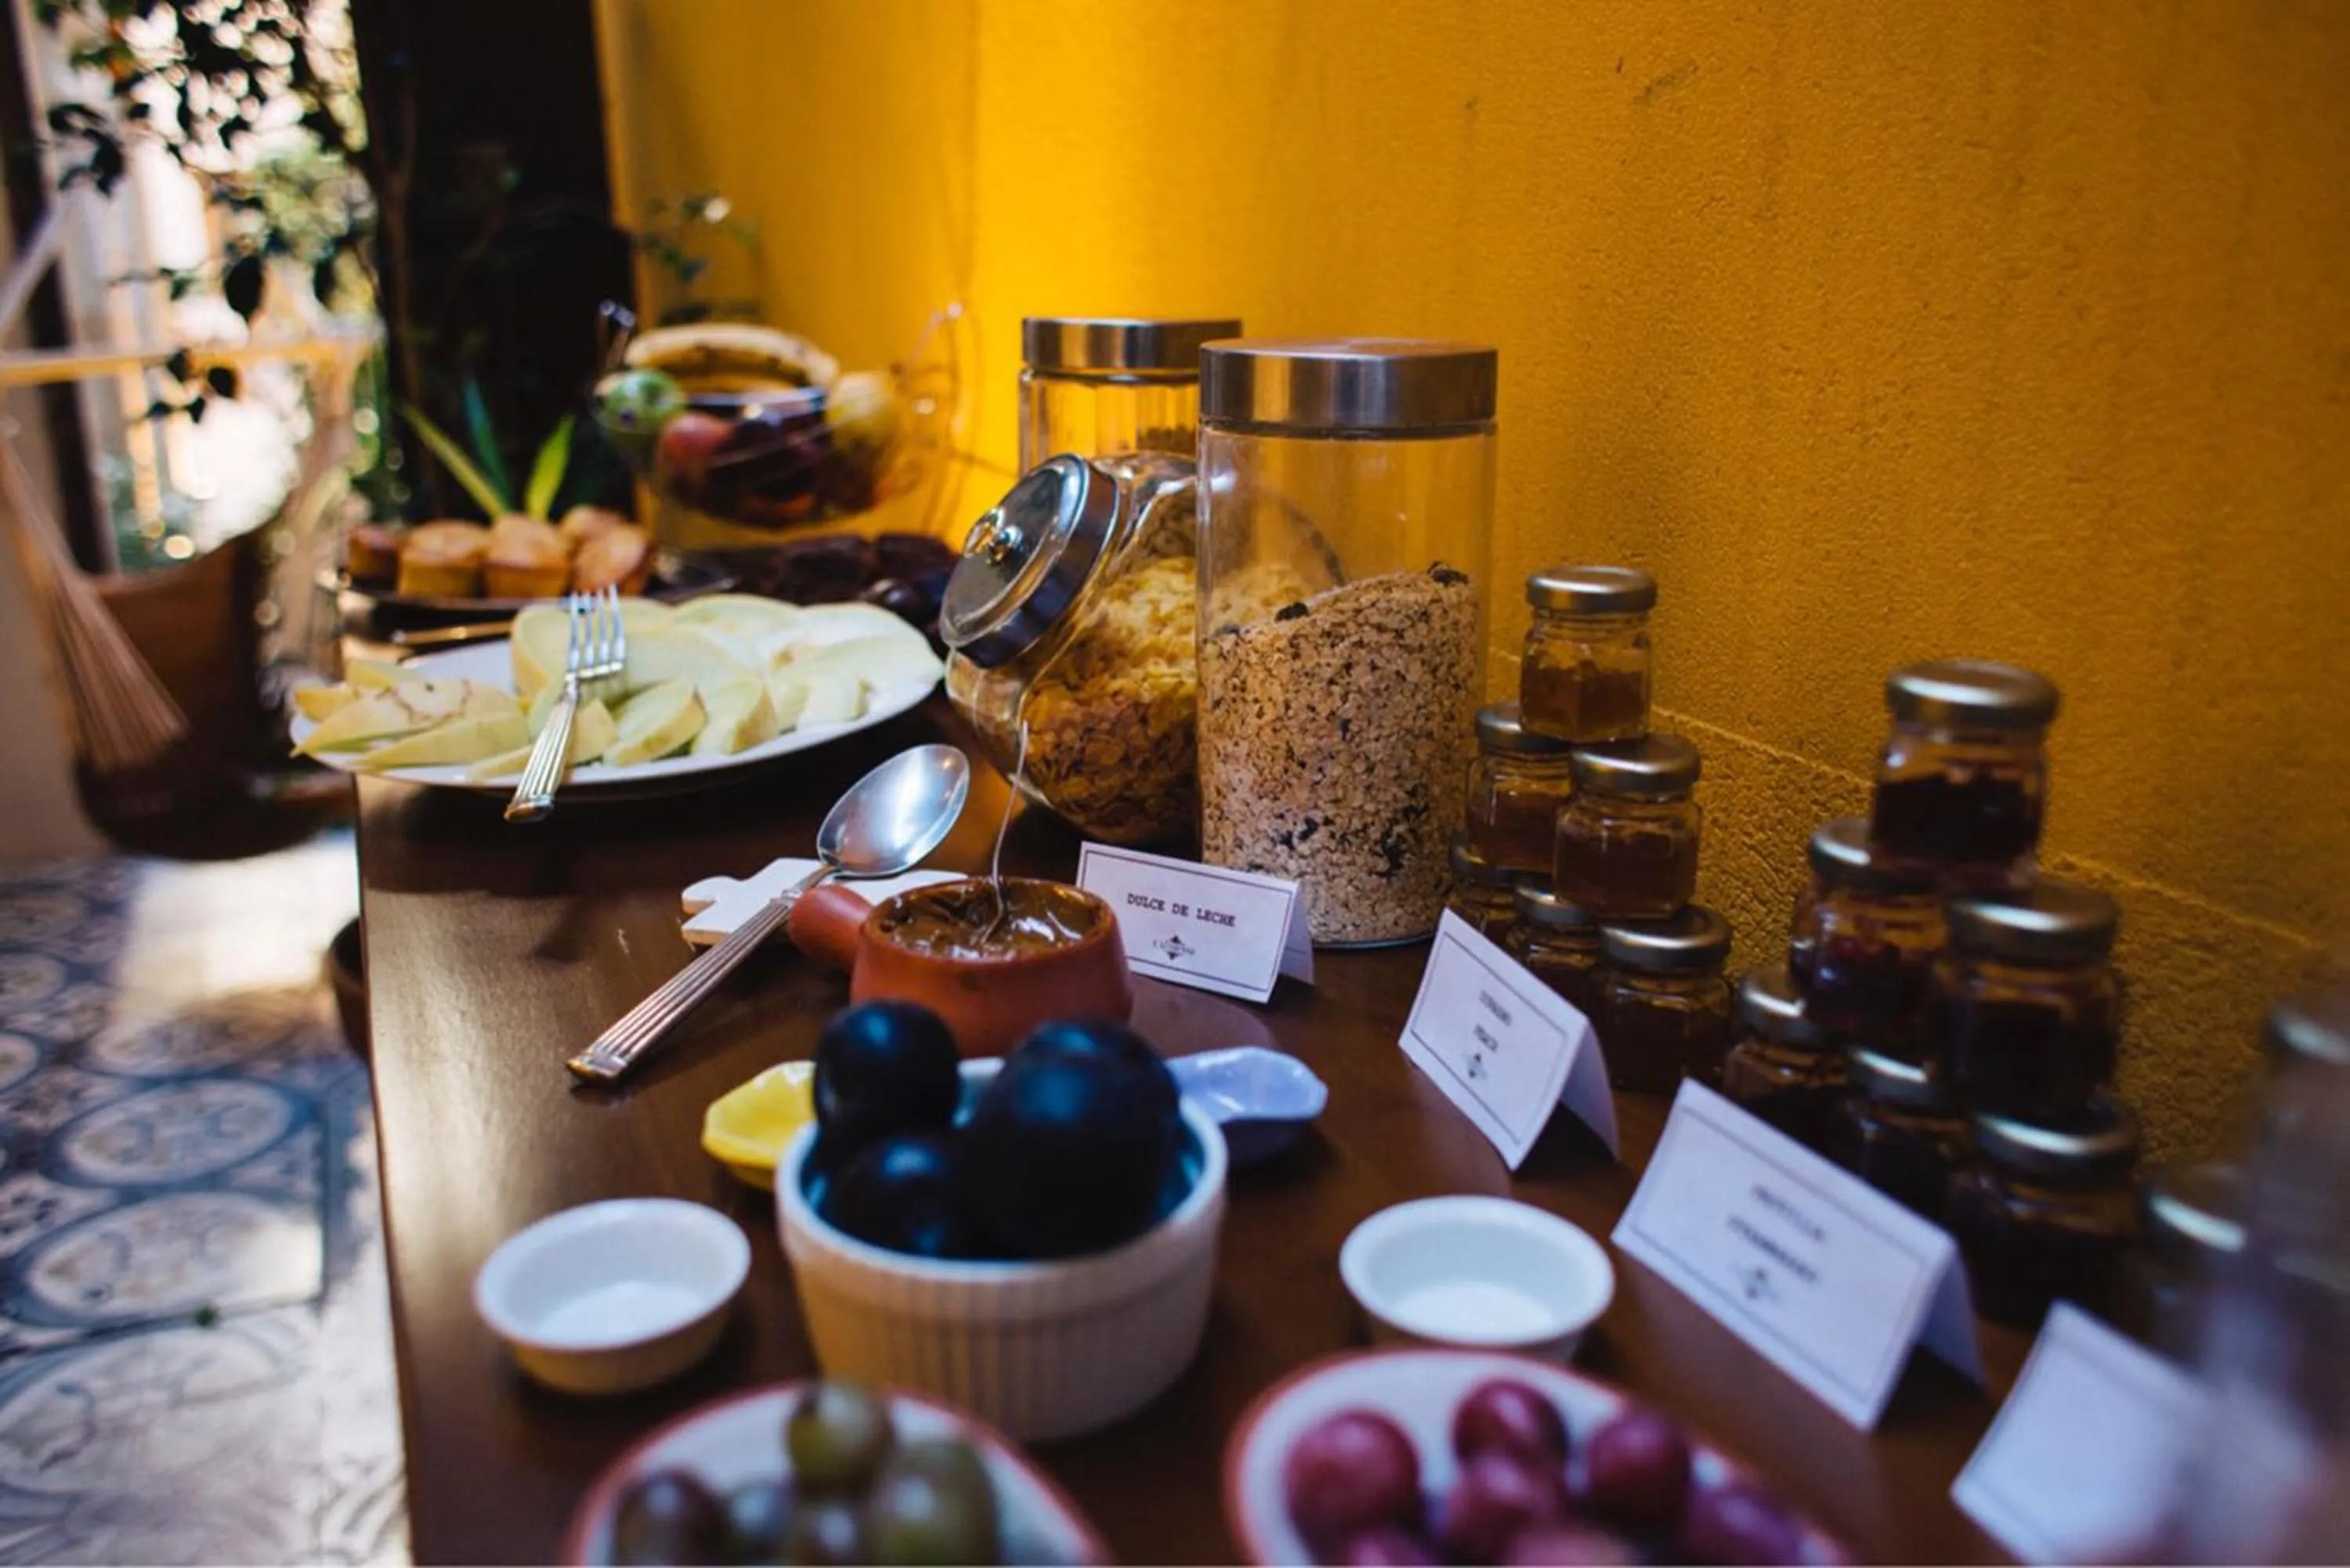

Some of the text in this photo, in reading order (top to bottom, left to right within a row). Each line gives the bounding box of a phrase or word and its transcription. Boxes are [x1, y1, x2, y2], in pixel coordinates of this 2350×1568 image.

[1126, 892, 1237, 927] DULCE DE LECHE
